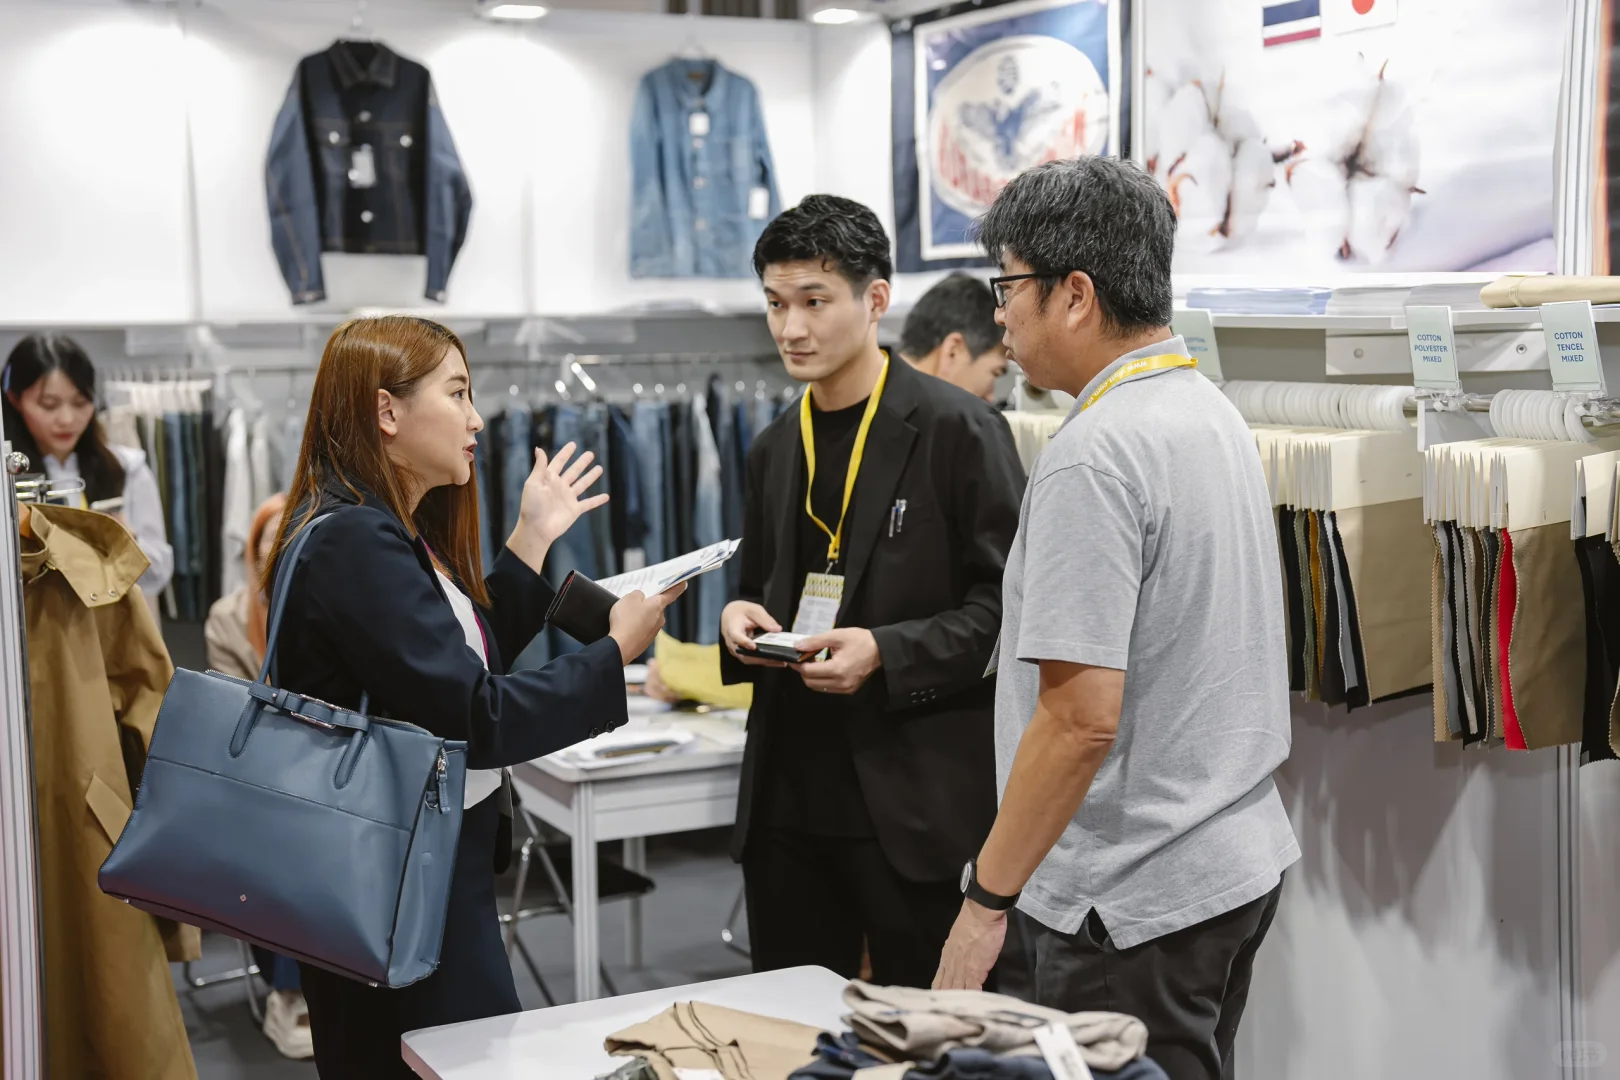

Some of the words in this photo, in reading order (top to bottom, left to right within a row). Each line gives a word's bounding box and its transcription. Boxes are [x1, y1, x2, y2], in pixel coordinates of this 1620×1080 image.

[1416, 333, 1442, 342] COTTON
[1554, 331, 1584, 341] COTTON
[1414, 344, 1448, 353] POLYESTER
[1557, 343, 1584, 351] TENCEL
[1423, 355, 1442, 363] MIXED
[1561, 354, 1584, 363] MIXED
